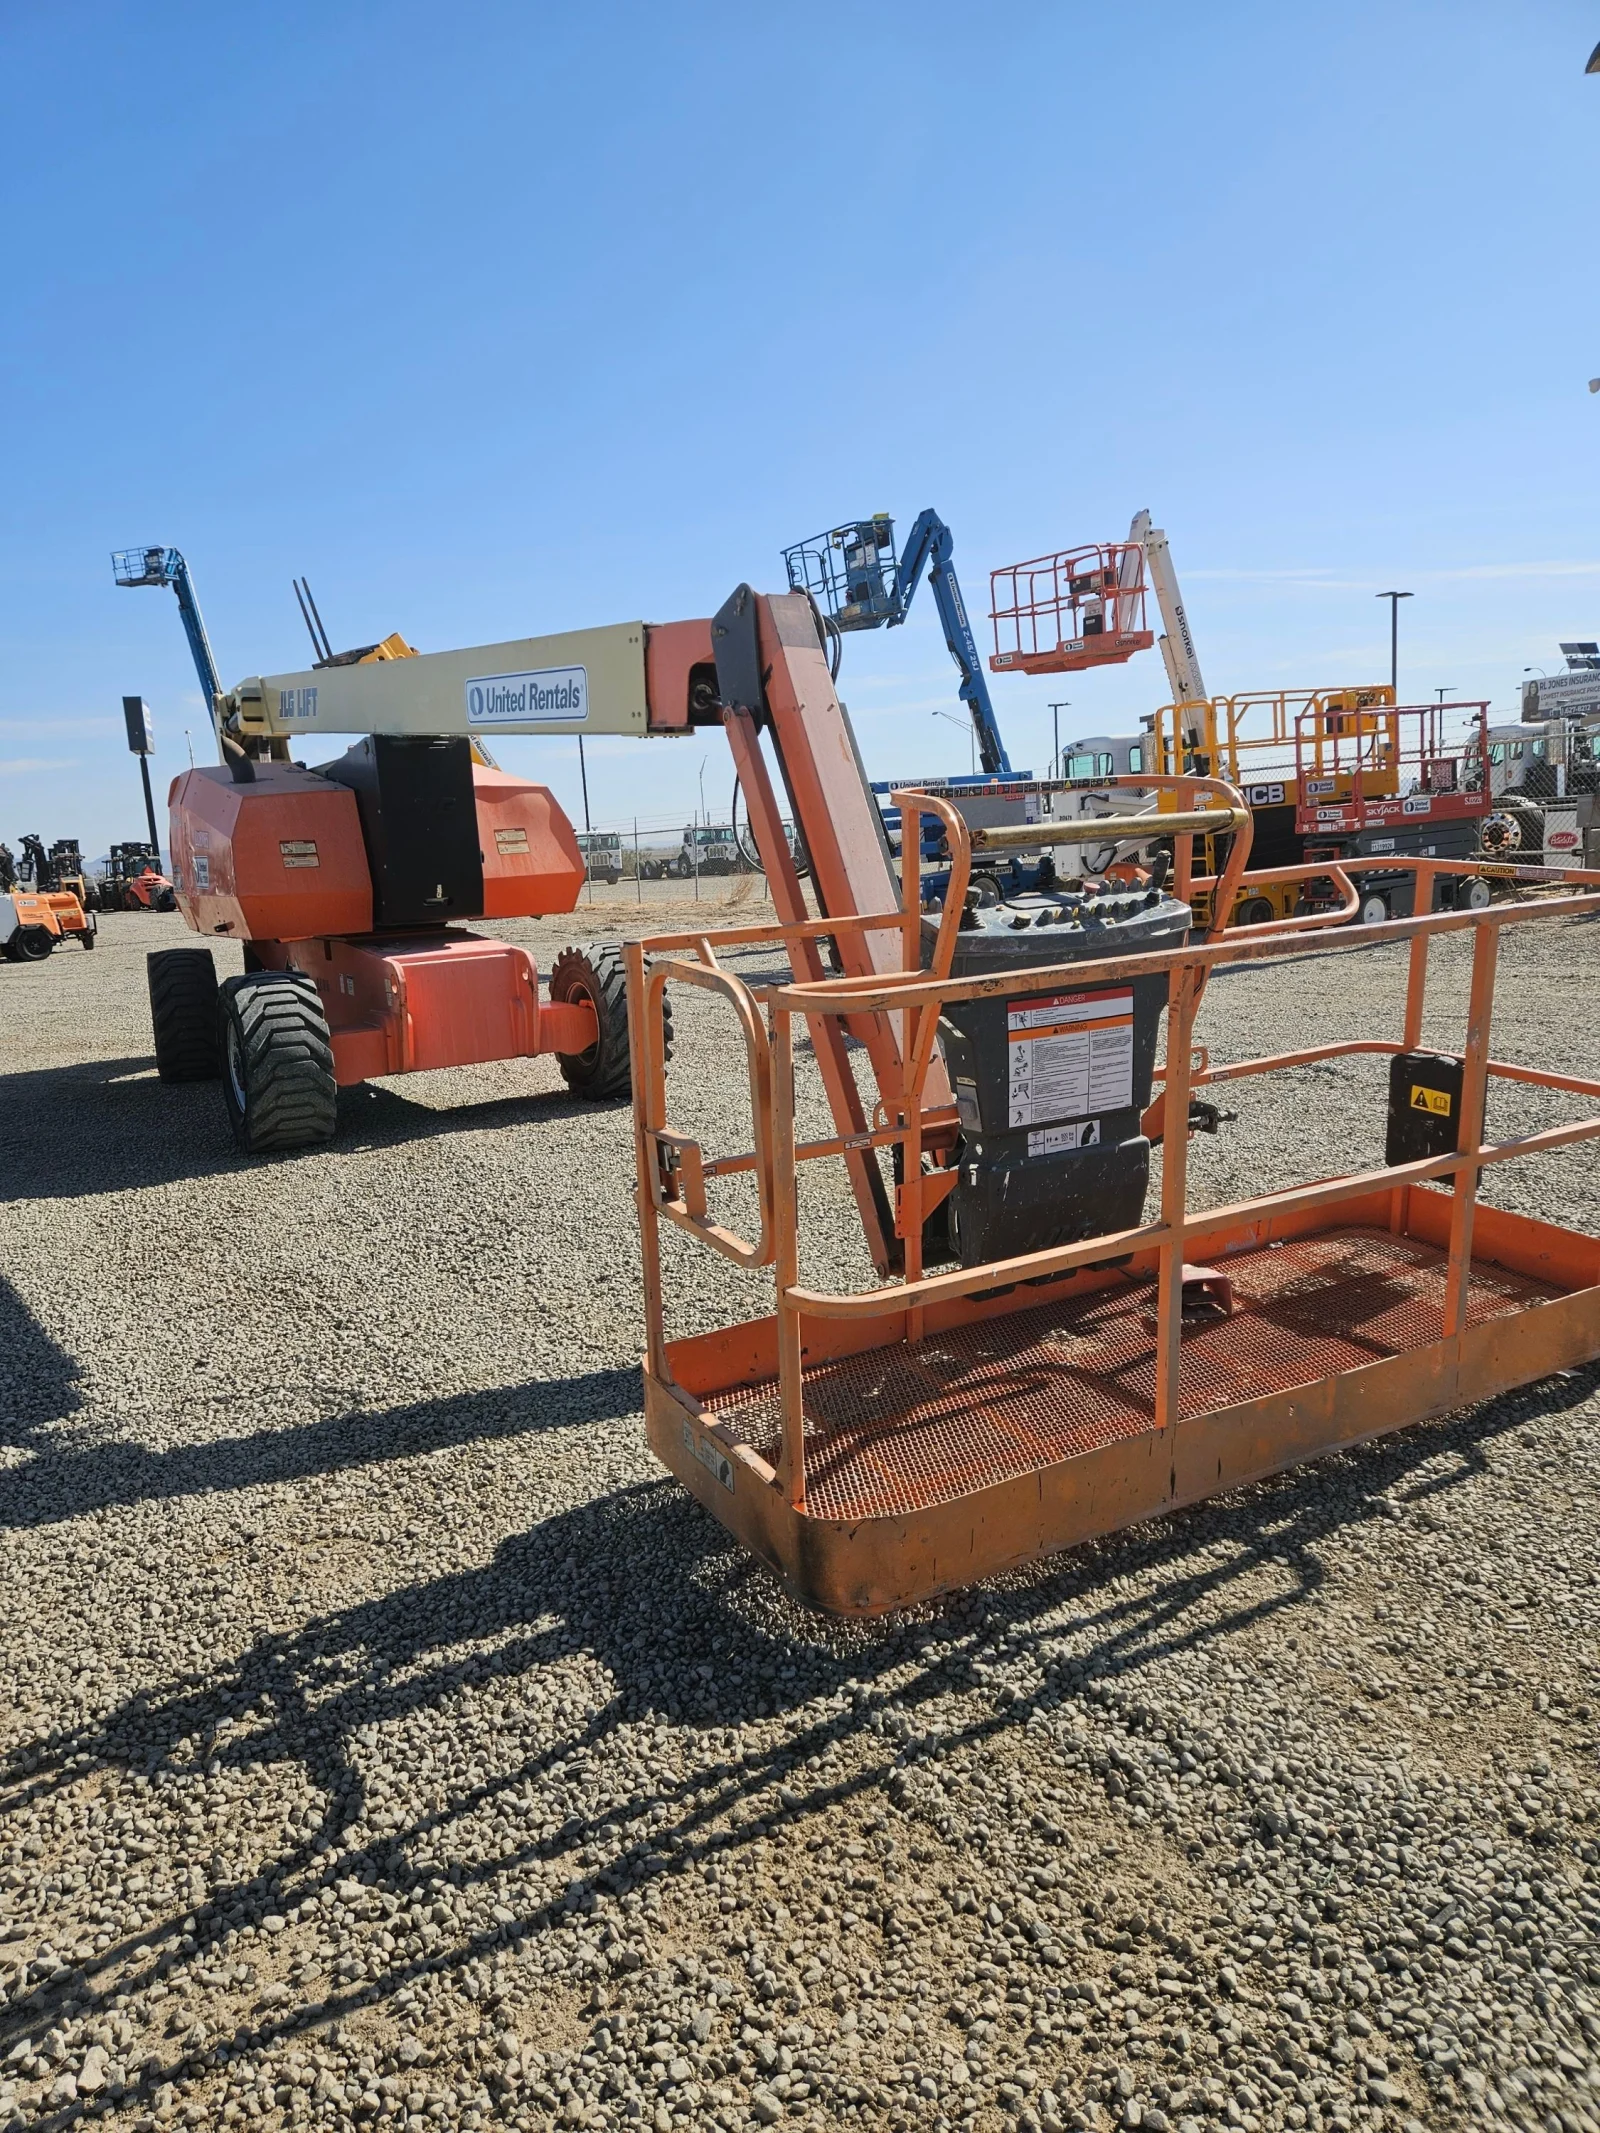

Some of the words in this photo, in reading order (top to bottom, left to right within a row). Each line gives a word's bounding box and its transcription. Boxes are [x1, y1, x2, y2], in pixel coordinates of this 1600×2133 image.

[1177, 616, 1195, 659] snorkel
[1540, 682, 1547, 691] RL
[1548, 677, 1568, 689] JONES
[279, 690, 294, 718] JLG
[297, 687, 318, 718] LIFT
[486, 683, 526, 713] United
[529, 679, 580, 711] Rentals
[474, 740, 492, 766] Rentals
[922, 780, 946, 788] Rentals
[1366, 804, 1400, 816] SKYJACK
[1486, 866, 1515, 875] CAUTION
[1059, 994, 1086, 1005] DANGER
[1058, 1023, 1088, 1034] WARNING
